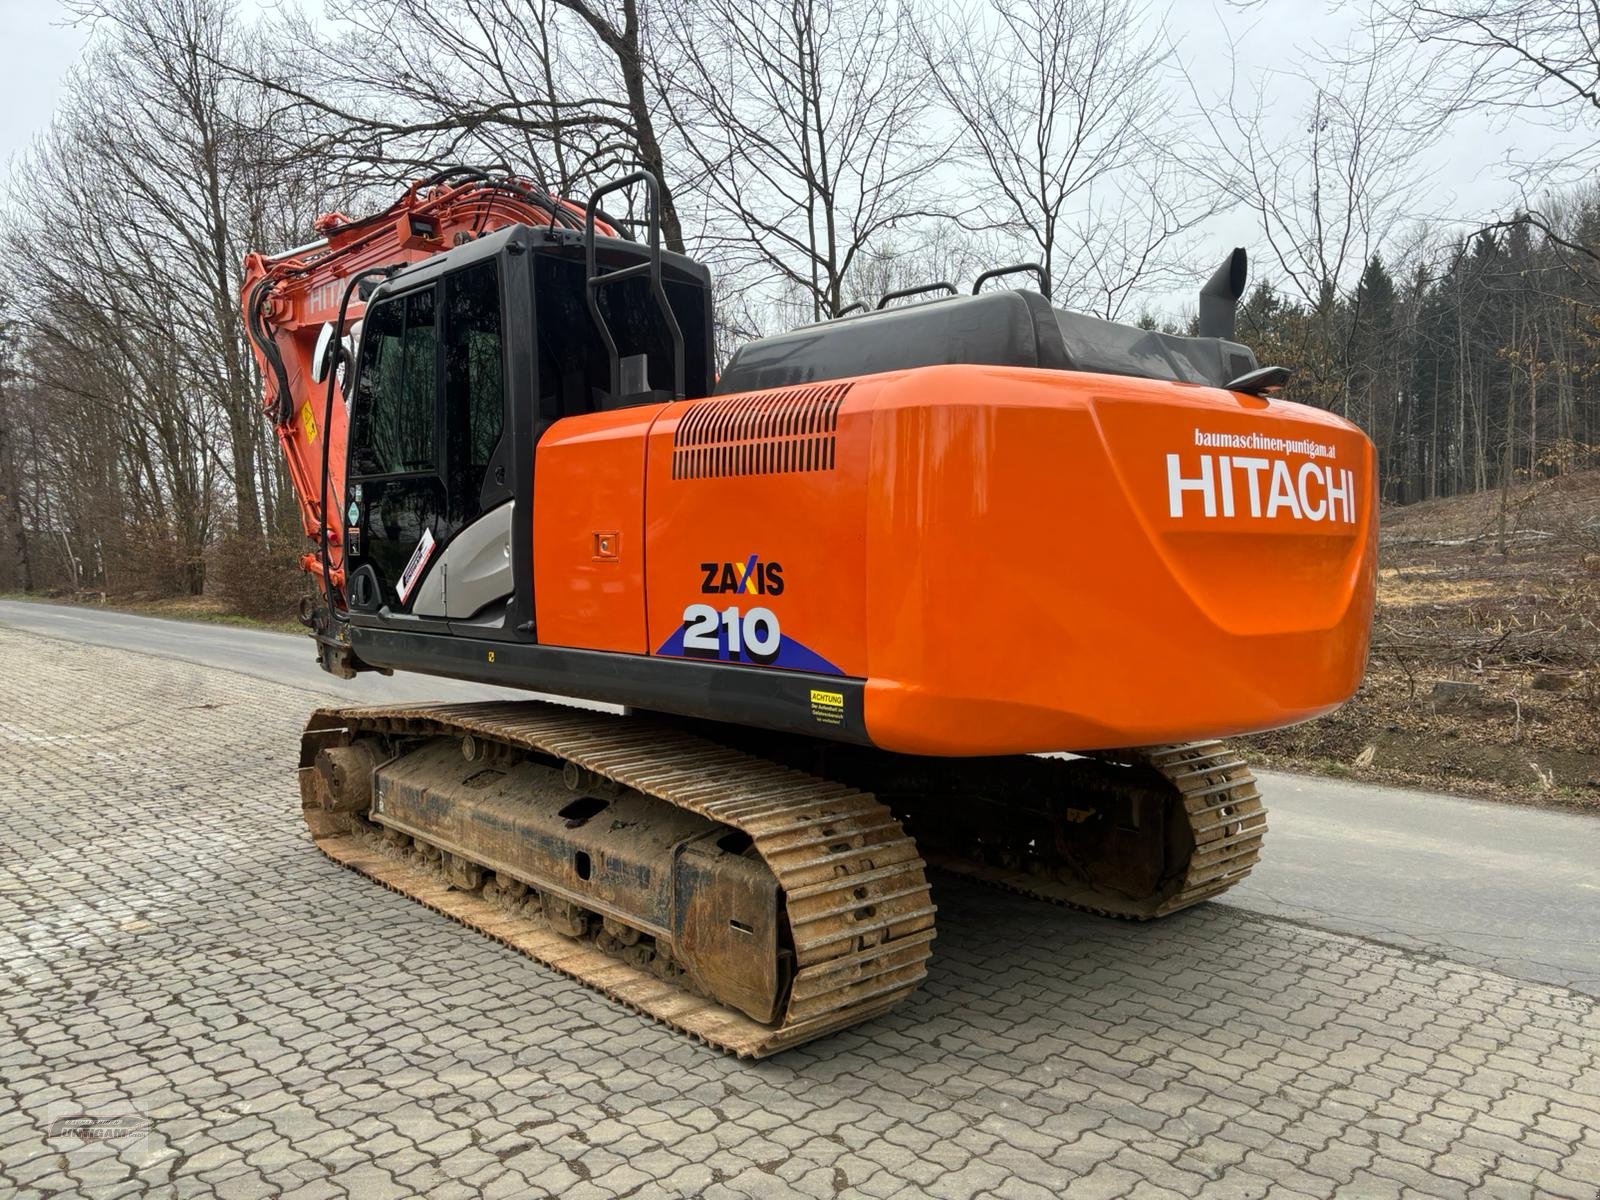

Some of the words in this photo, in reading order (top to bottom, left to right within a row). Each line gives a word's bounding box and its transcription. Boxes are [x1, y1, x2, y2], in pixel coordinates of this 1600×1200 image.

[1194, 428, 1336, 459] baumaschinen-puntigam.at
[1166, 454, 1356, 524] HITACHI
[701, 554, 784, 596] ZAXIS
[682, 603, 781, 665] 210
[812, 693, 842, 704] ACHTUNG
